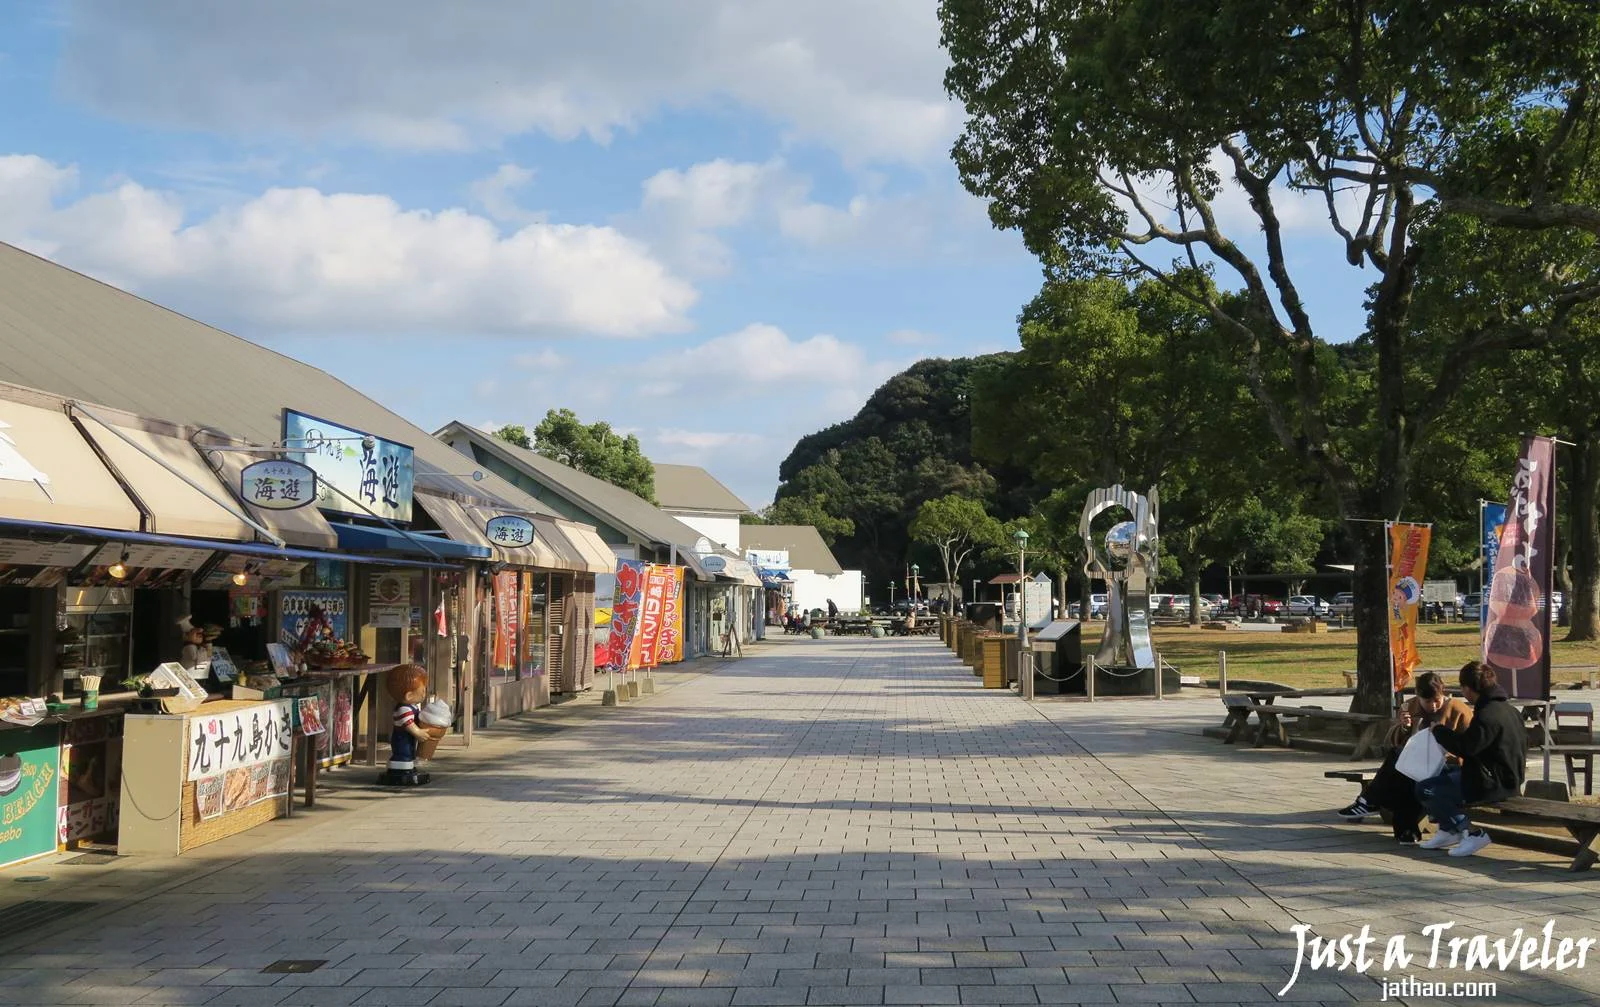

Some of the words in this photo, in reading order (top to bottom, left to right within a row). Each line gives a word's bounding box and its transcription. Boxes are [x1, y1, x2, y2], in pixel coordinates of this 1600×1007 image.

[254, 477, 300, 501] 海遊
[494, 526, 524, 543] 海遊
[192, 706, 292, 774] 九十九島かき
